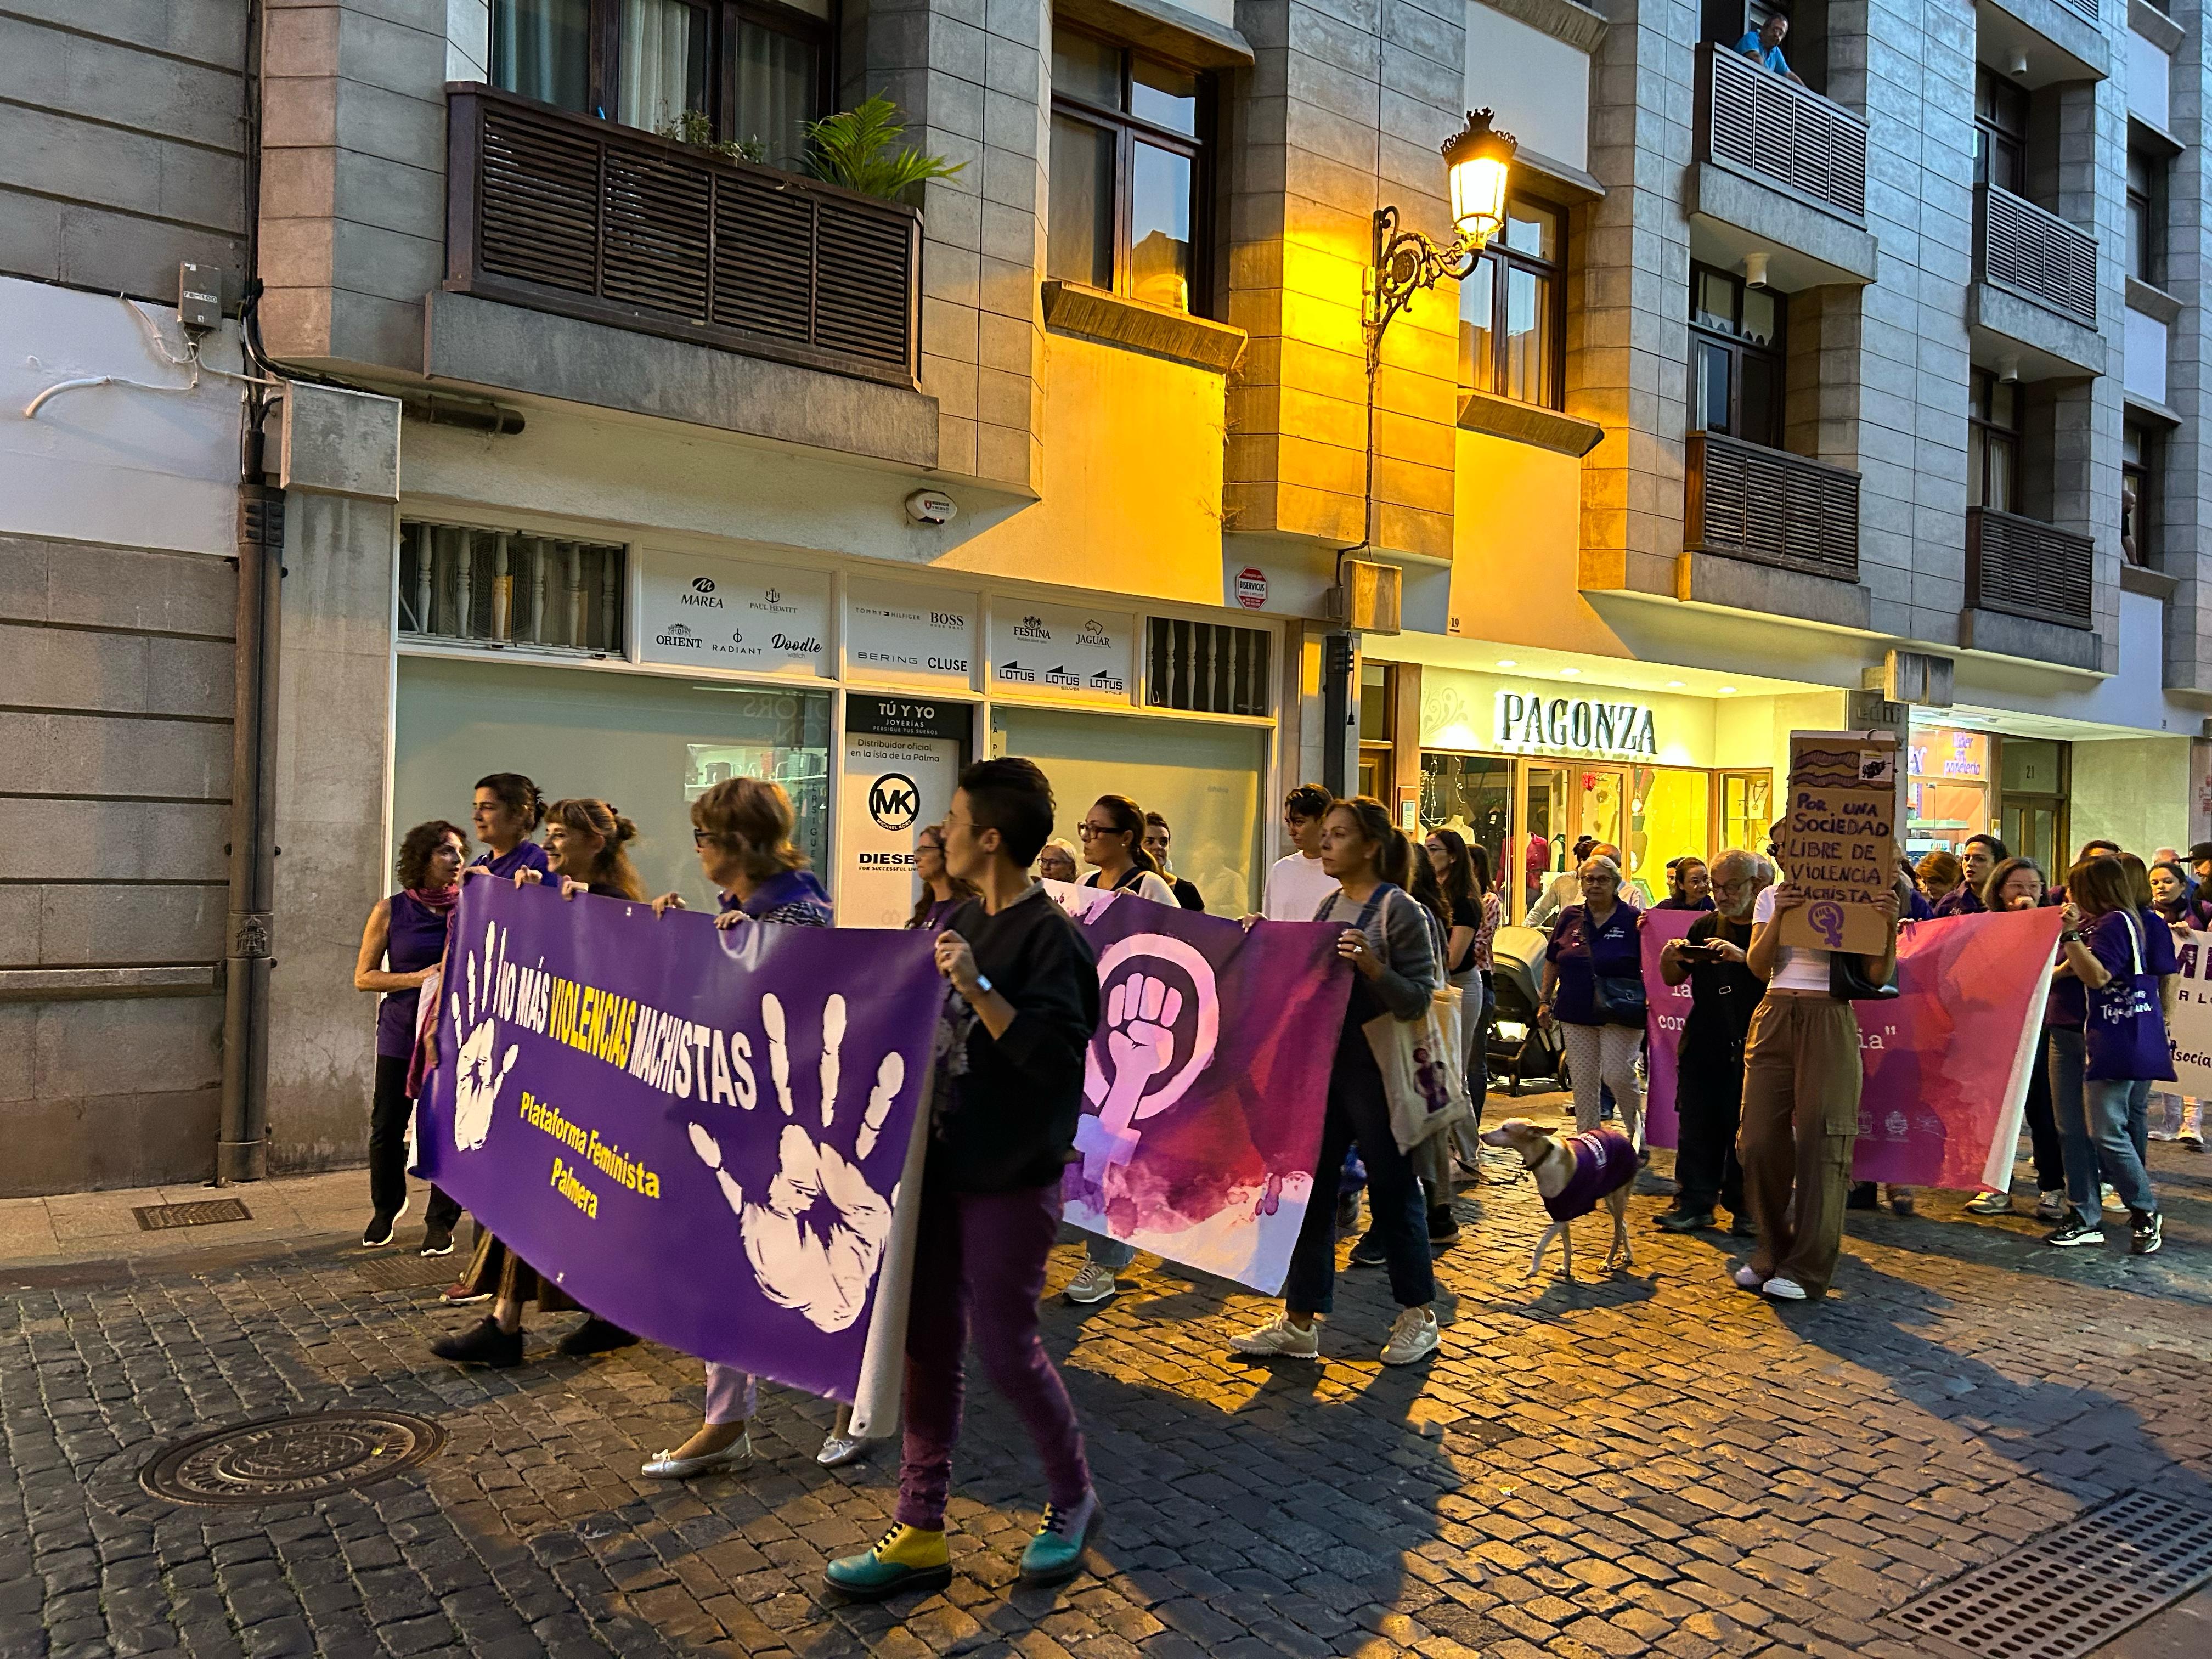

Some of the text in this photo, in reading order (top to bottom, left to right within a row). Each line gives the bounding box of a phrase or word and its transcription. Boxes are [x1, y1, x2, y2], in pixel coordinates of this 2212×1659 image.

[681, 594, 723, 608] MAREA
[750, 602, 797, 613] PAUL HEWITT
[856, 607, 920, 620] TOMMY HILFIGER
[930, 612, 964, 627] BOSS
[1451, 617, 1459, 628] 19
[1014, 626, 1051, 639] FESTINA
[656, 635, 702, 648] ORIENT
[772, 633, 823, 653] Doodle
[1076, 634, 1111, 648] JAGUAR
[713, 644, 763, 656] RADIANT
[858, 652, 918, 665] BERING
[928, 657, 967, 672] CLUSE
[1000, 669, 1035, 682] LOTUS
[1046, 674, 1080, 686] LOTUS
[1090, 678, 1122, 690] LOTUS
[879, 701, 935, 719] TÚ Y YO
[885, 718, 924, 727] JOYERÍAS
[1502, 694, 1657, 754] PAGONZA
[858, 739, 932, 751] Distribuidor oficial
[913, 752, 939, 762] Palma
[2027, 765, 2034, 778] 21
[876, 789, 913, 815] MK
[877, 819, 912, 830] MICHAEL KORS
[1852, 843, 1876, 861] DE
[859, 853, 915, 865] DIESE
[498, 956, 757, 1110] NO MÁS VIOLENCIAS MACHISTAS
[520, 1091, 660, 1199] Plataforma Feminista
[551, 1158, 598, 1219] Palmera
